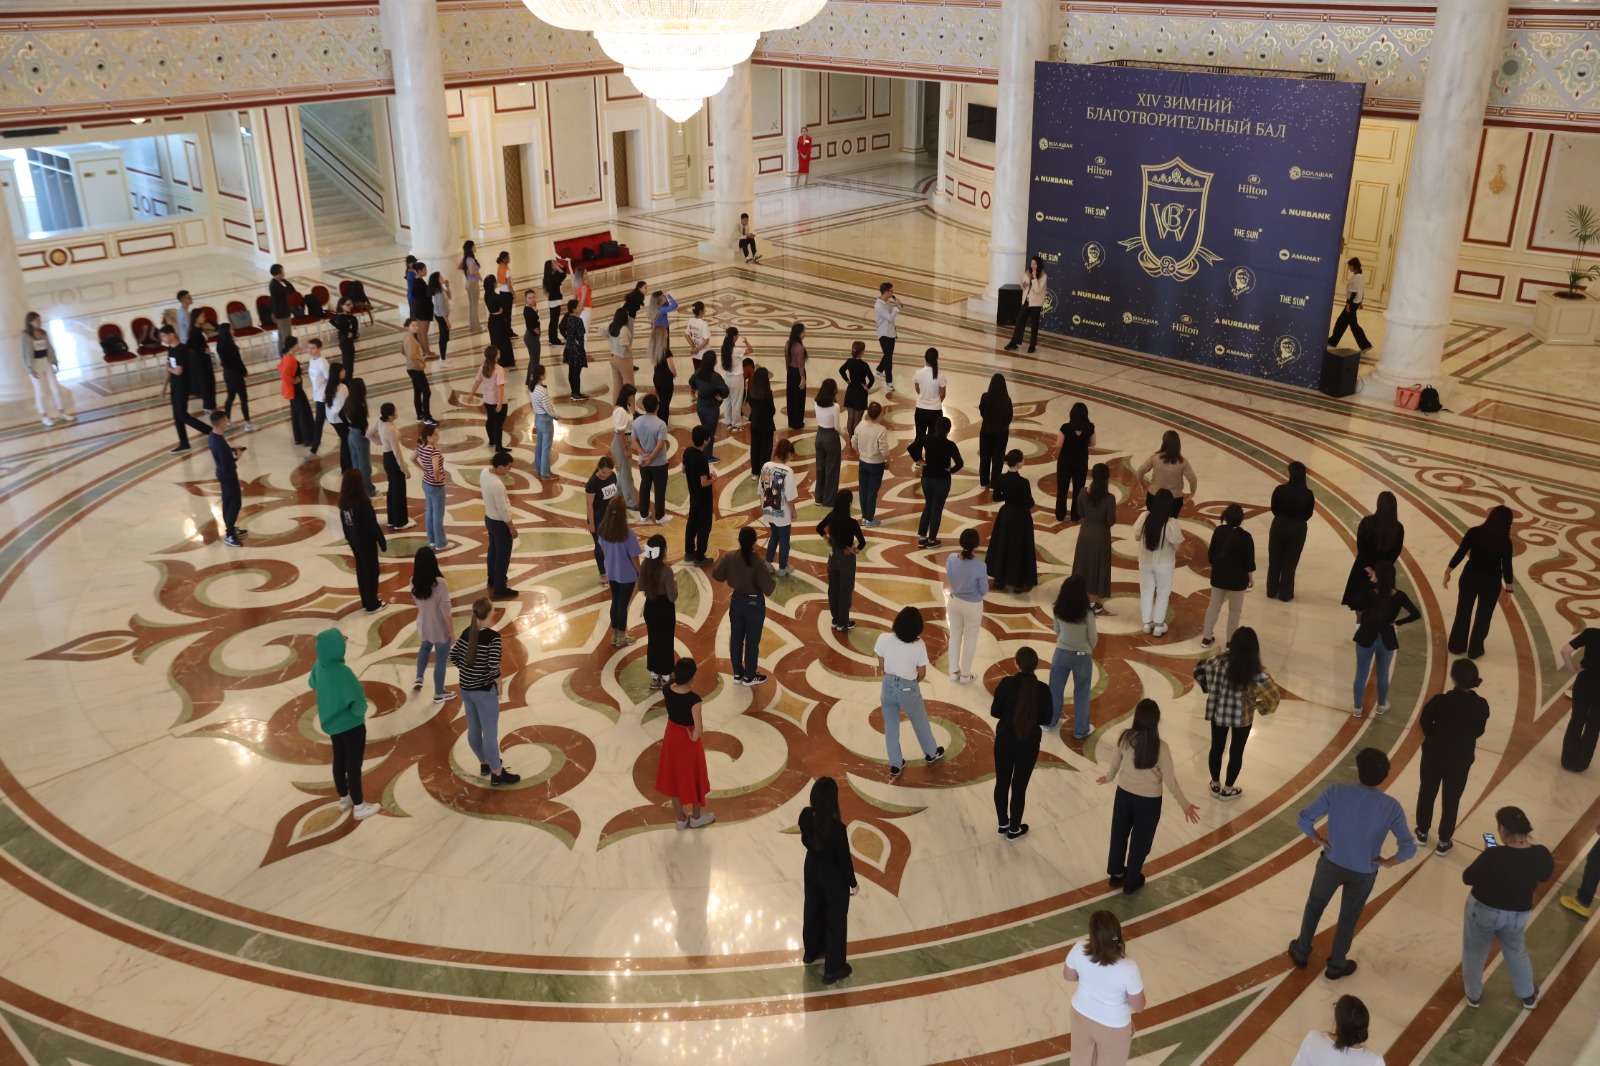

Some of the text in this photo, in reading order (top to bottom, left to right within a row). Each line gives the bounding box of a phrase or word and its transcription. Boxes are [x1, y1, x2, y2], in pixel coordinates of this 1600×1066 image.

[1163, 95, 1233, 114] ЗИМНИЙ
[1086, 106, 1287, 139] БЛАГОТВОРИТЕЛЬНЫЙ БАЛ
[1087, 165, 1113, 176] Hilton
[1040, 175, 1074, 186] NURBANK
[1238, 184, 1268, 196] Hilton
[1085, 206, 1095, 215] THE
[1095, 207, 1106, 217] SUN
[1288, 208, 1331, 220] NURBANK
[1233, 228, 1259, 240] THE SUN
[1048, 253, 1059, 263] SUN
[1291, 253, 1321, 262] AMANAT
[1077, 290, 1111, 302] NURBANK
[1280, 294, 1306, 307] THE SUN
[1082, 319, 1106, 328] AMANAT
[1172, 322, 1199, 336] Hilton
[1221, 318, 1260, 332] NURBANK
[1226, 349, 1253, 359] AMANAT
